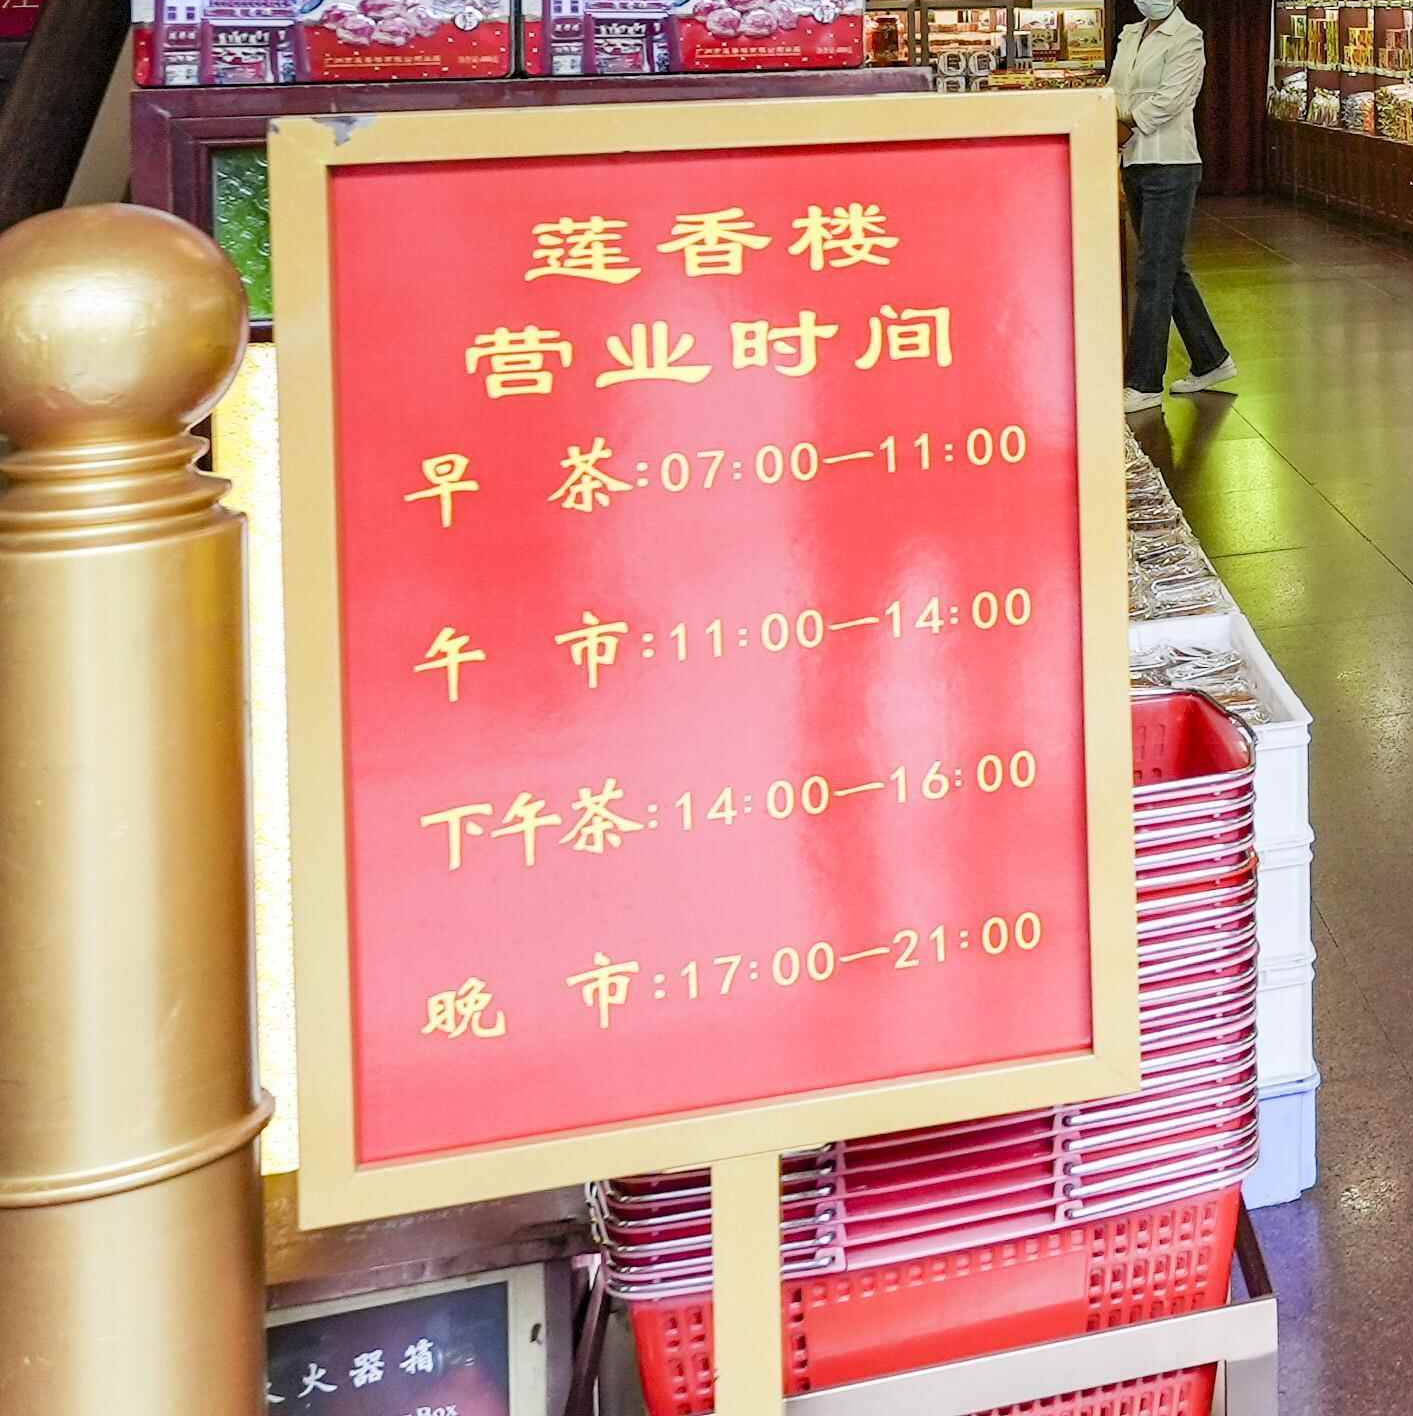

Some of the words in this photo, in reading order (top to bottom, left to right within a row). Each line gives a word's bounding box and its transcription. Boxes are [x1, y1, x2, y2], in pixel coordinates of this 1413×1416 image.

[524, 201, 902, 286] 莲香楼
[464, 304, 956, 400] 营业时间
